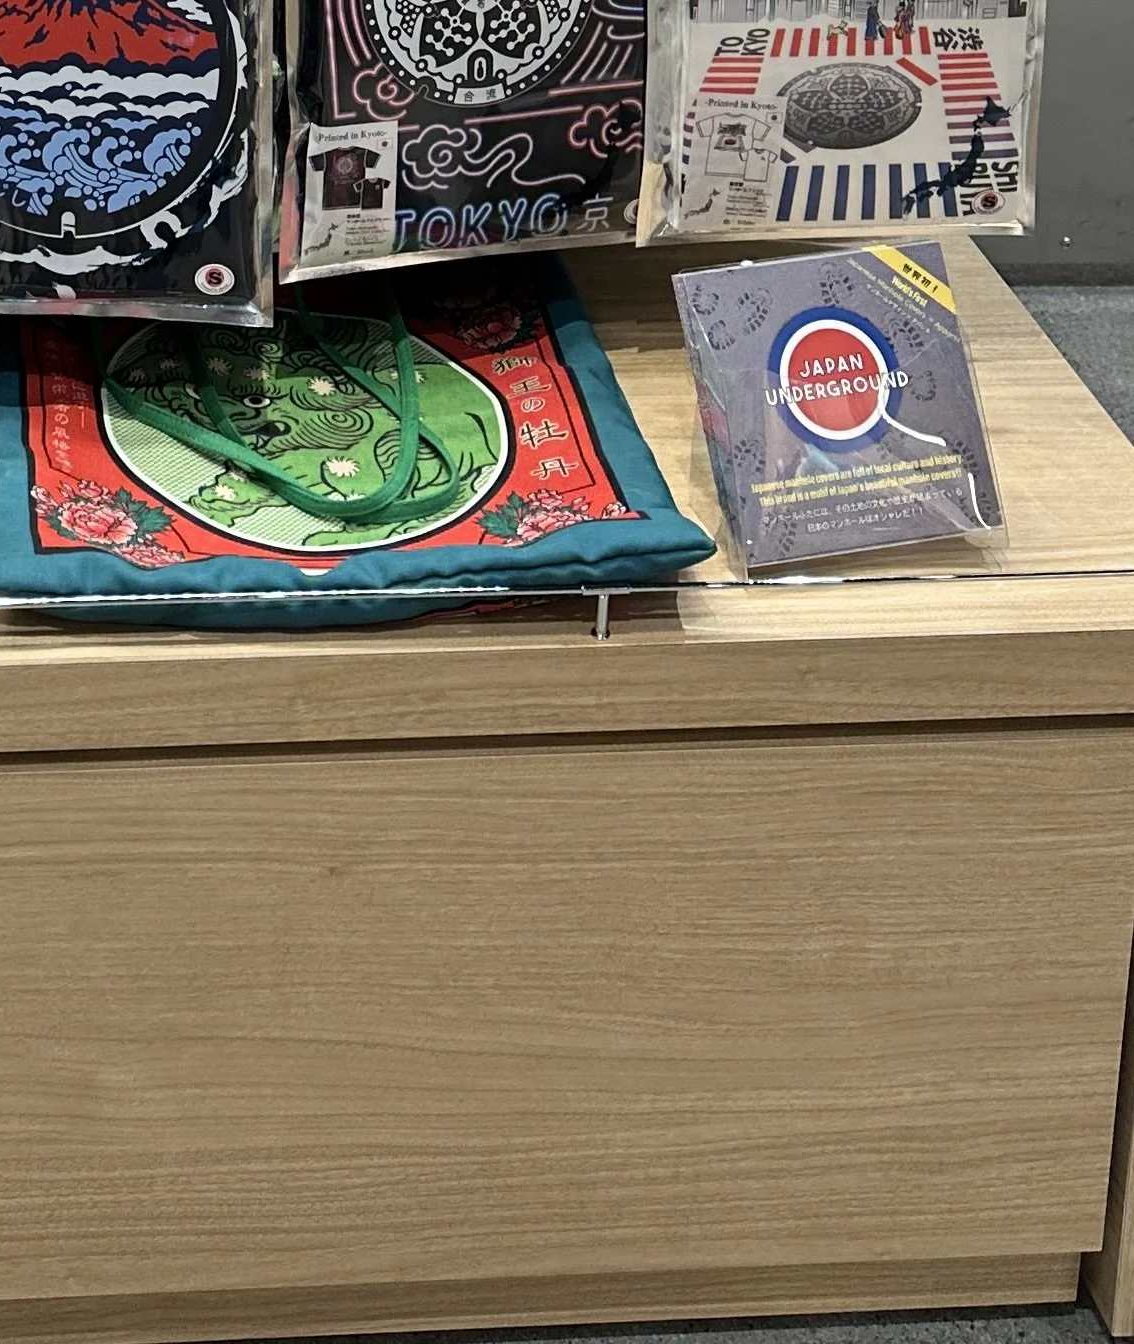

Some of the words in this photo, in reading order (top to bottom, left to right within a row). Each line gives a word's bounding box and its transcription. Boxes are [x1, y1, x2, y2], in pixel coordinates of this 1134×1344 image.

[714, 36, 745, 56] TO
[740, 27, 771, 56] KYO
[932, 26, 986, 52] 渋谷
[395, 192, 568, 252] TOKYO
[576, 193, 614, 232] 京
[798, 352, 864, 378] JAPAN
[764, 370, 910, 406] UNDERGROUND
